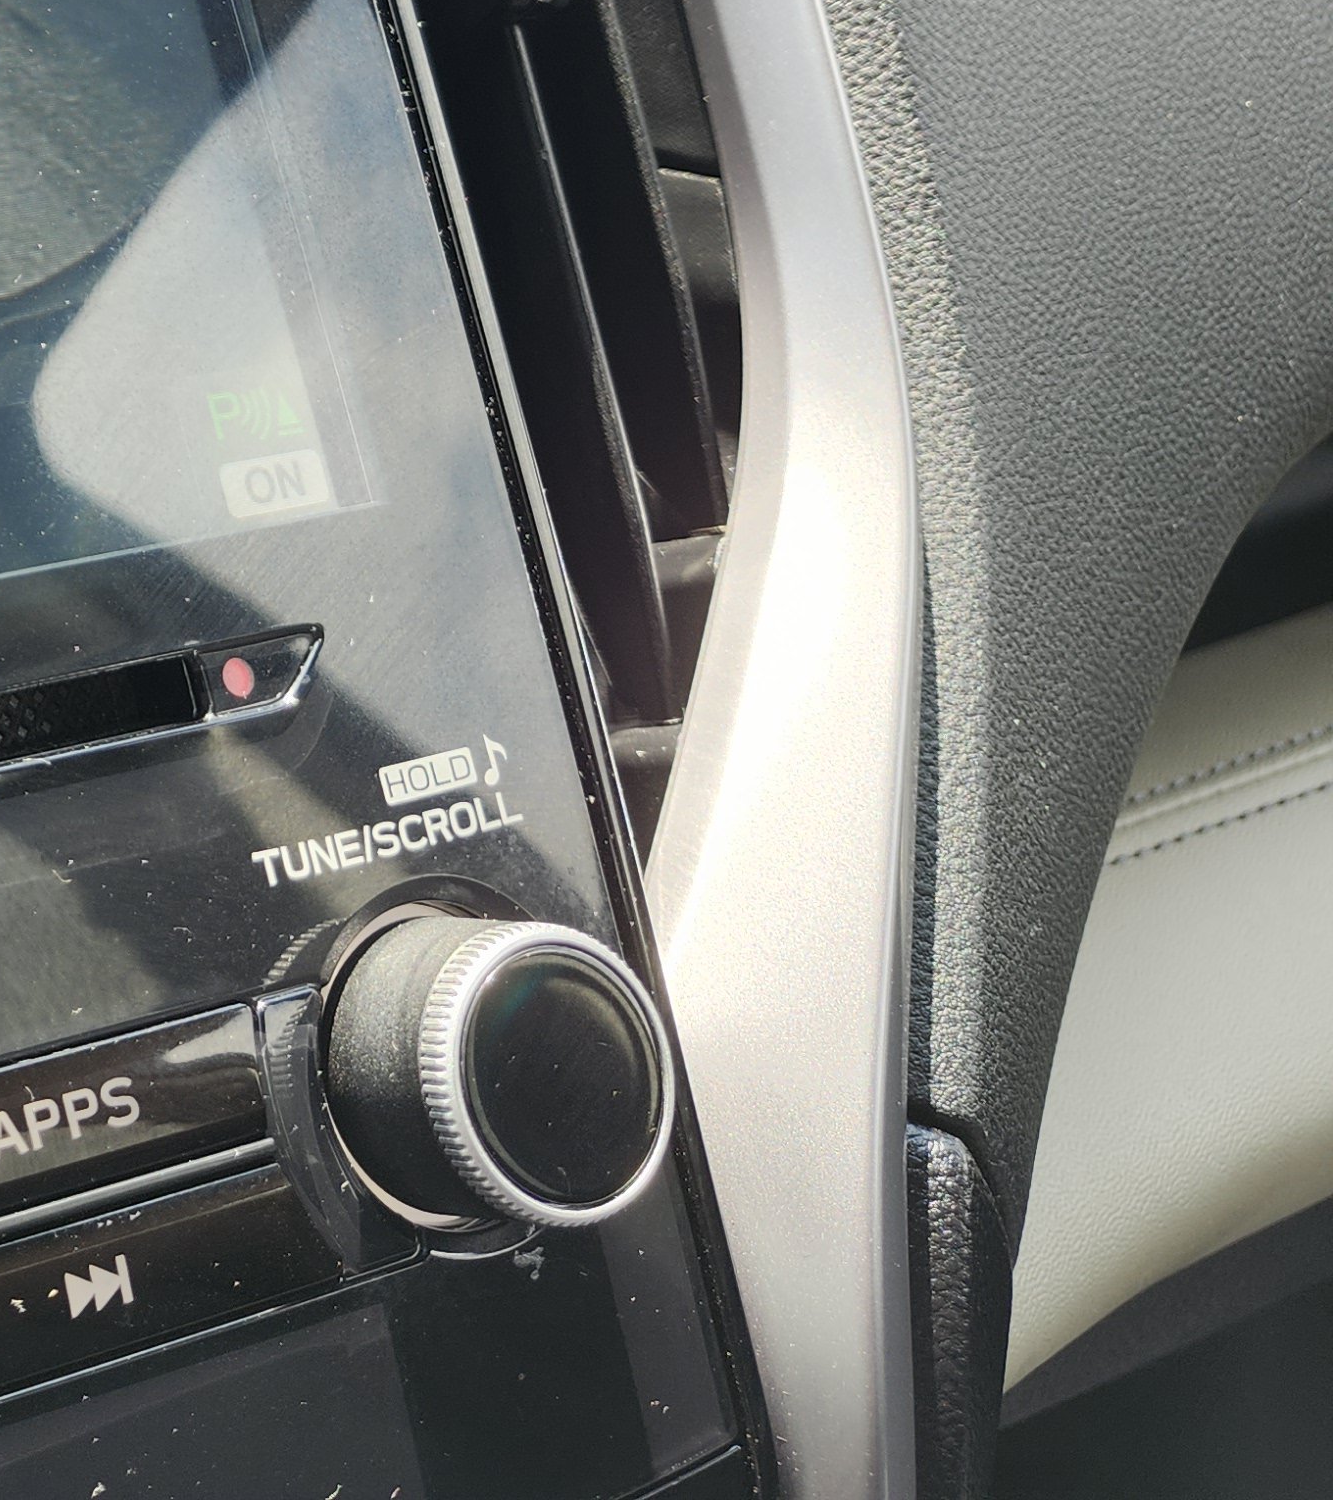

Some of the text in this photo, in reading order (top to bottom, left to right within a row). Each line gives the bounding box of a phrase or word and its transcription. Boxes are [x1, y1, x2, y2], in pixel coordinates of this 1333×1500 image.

[244, 460, 307, 504] ON
[383, 754, 472, 799] HOLD
[251, 791, 524, 887] TUNE/SCROLL
